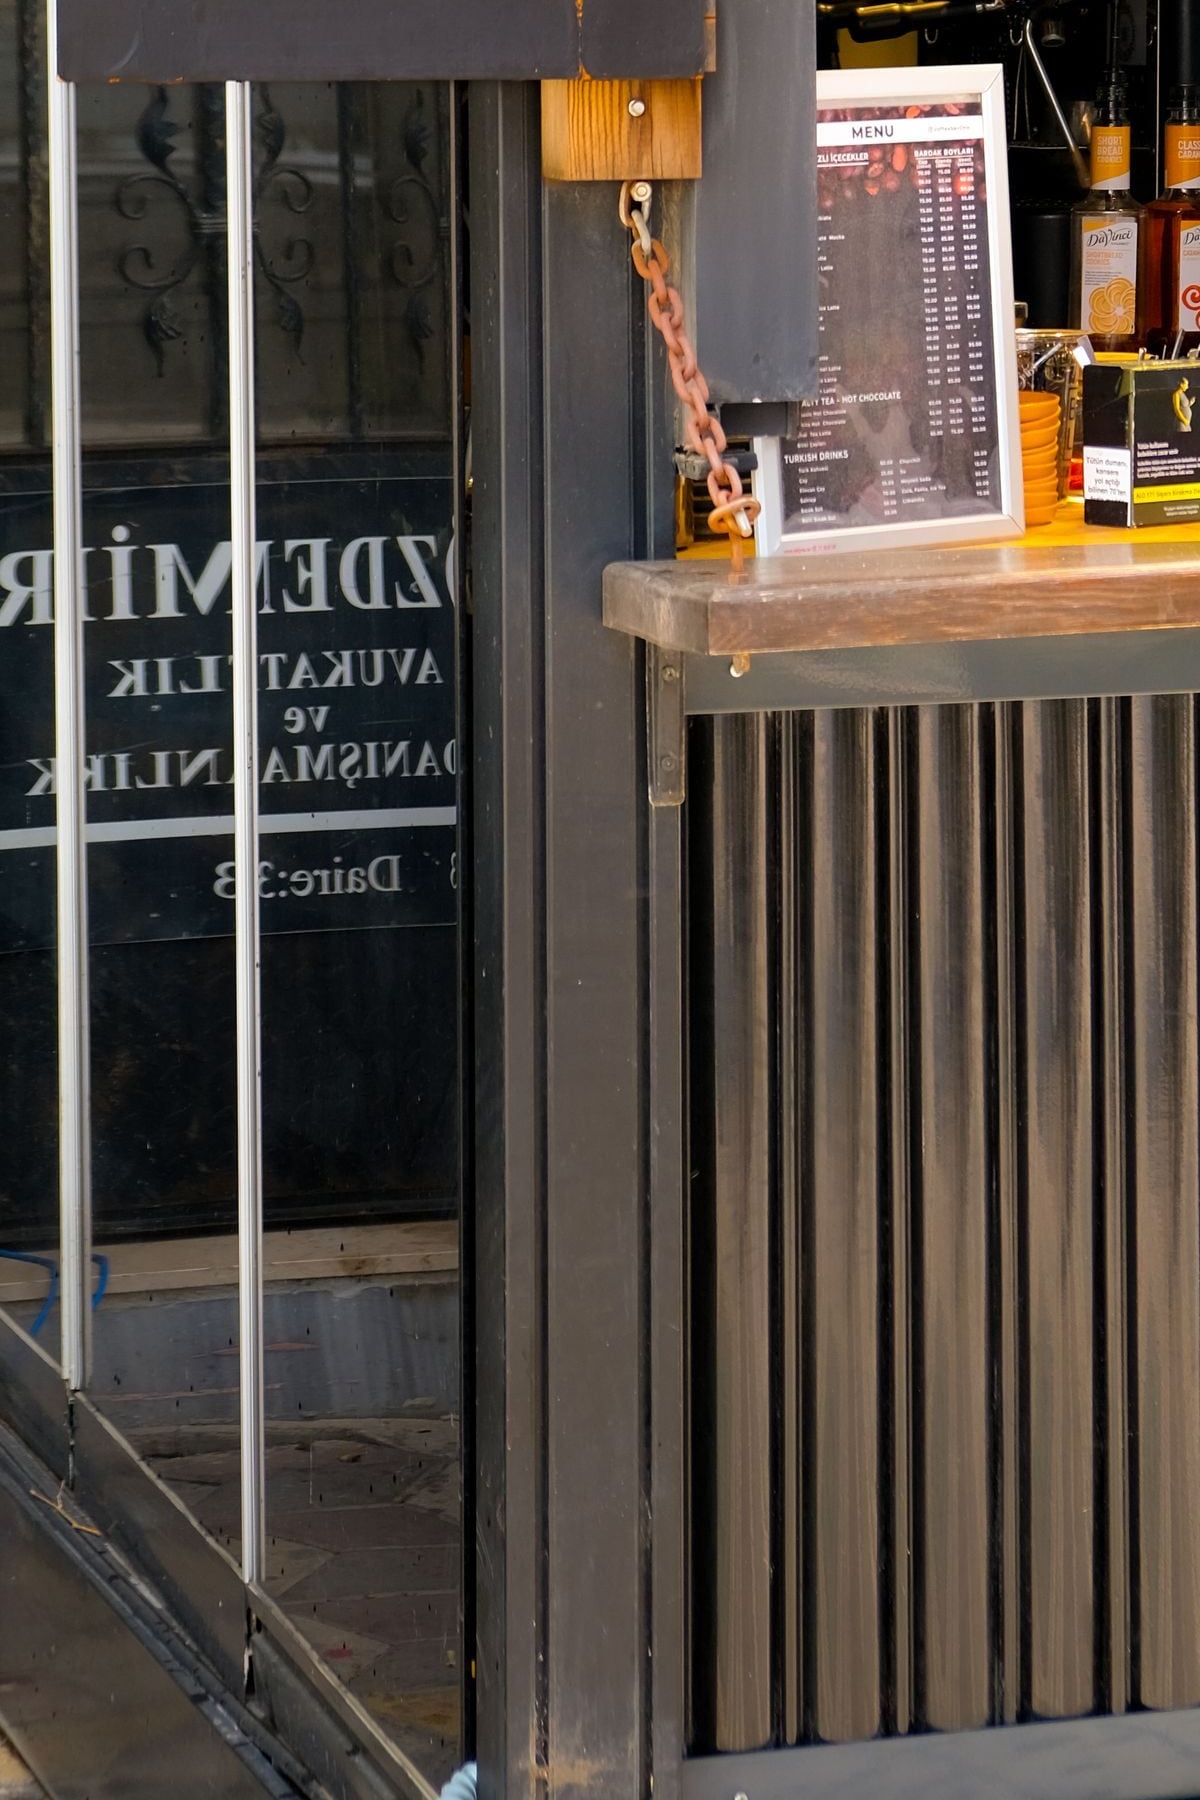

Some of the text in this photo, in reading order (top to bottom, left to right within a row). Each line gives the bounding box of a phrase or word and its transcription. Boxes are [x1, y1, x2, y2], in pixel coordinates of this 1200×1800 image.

[852, 125, 894, 139] MENU
[1097, 136, 1123, 146] SHORT
[1097, 146, 1123, 156] BREAD
[821, 397, 835, 406] TEA
[842, 395, 857, 404] HOT
[859, 392, 901, 402] CHOCOLATE
[784, 450, 848, 464] TURKISH DRINKS
